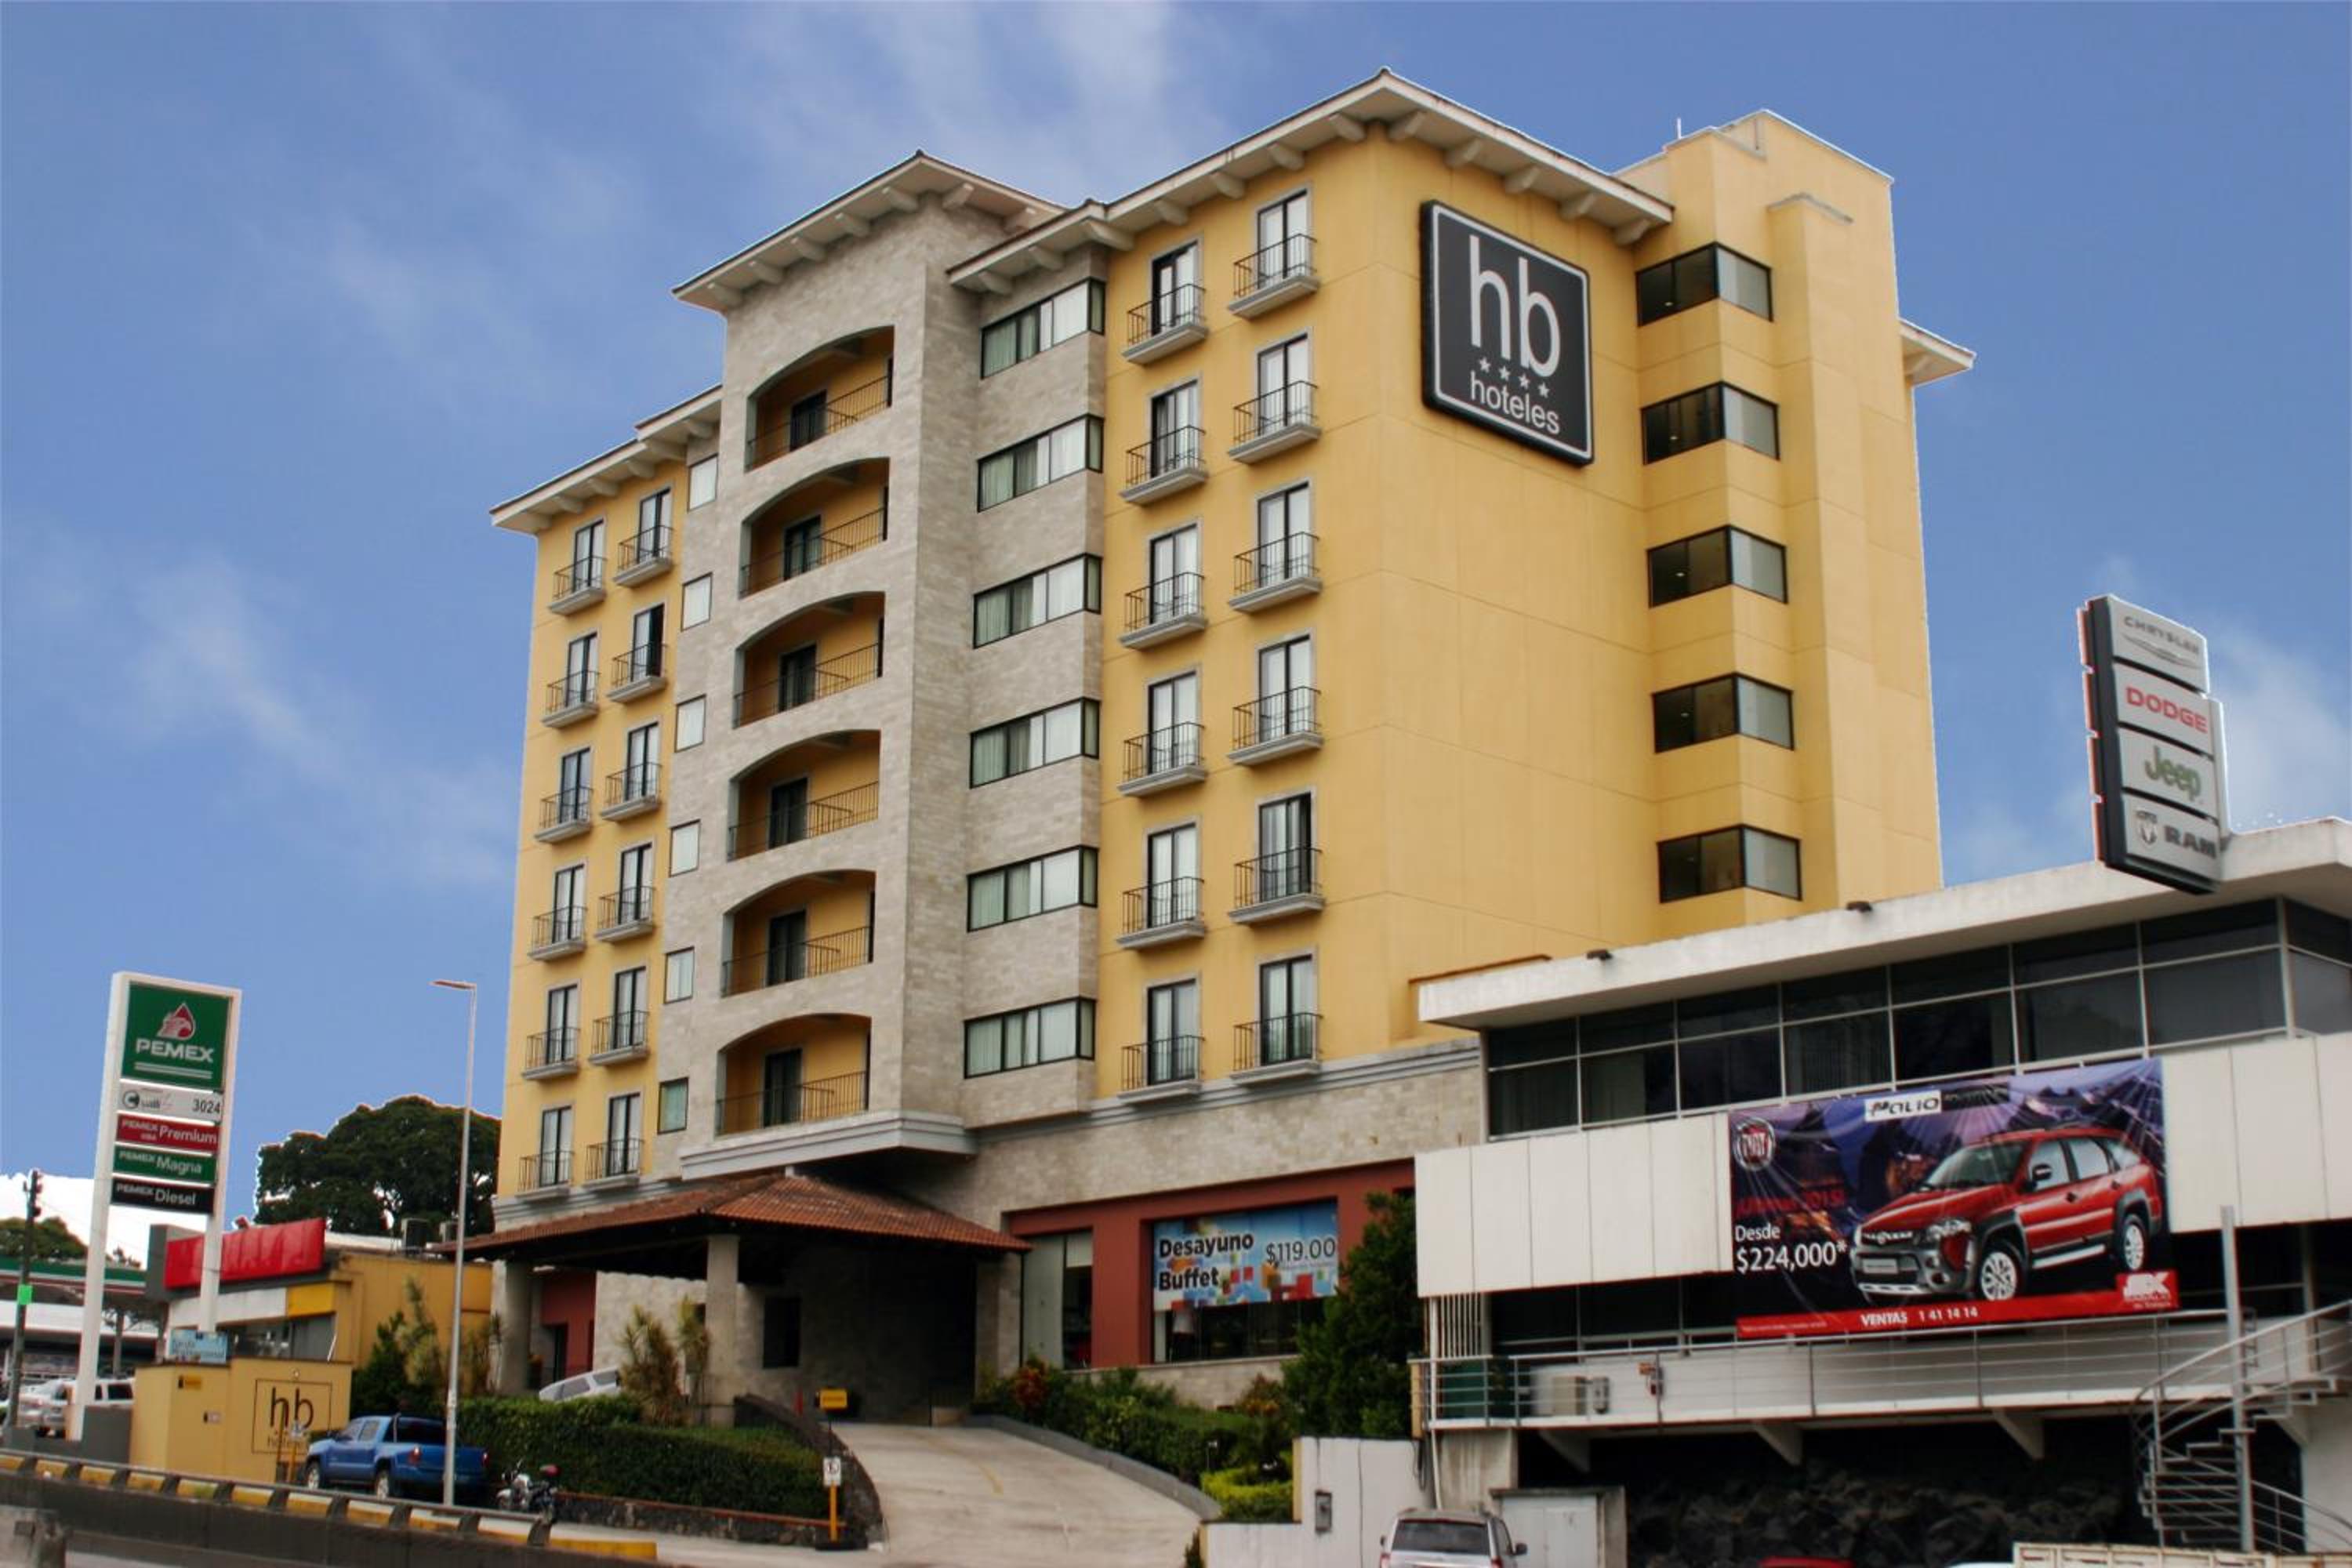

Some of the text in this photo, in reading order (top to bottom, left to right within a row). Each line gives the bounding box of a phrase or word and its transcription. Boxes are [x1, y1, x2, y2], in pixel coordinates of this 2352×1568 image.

[1469, 234, 1560, 377] hb
[1471, 370, 1559, 435] hoteles
[2124, 615, 2198, 655] CHRYSLER
[2125, 686, 2208, 734] DODGE
[2145, 746, 2201, 801] Jeep
[2164, 826, 2216, 859] RAM
[136, 1038, 214, 1063] PEMEX
[159, 1124, 217, 1144] Premium
[156, 1155, 201, 1176] Magna
[155, 1188, 197, 1205] Diesel
[1735, 1221, 1780, 1242] Desde
[1159, 1233, 1254, 1258] Desayuno
[1266, 1237, 1337, 1264] $119.00
[1159, 1266, 1220, 1291] Buffet
[1860, 1310, 1907, 1327] VENTAS
[1929, 1308, 1943, 1321] 41
[1963, 1305, 1979, 1319] 14
[270, 1387, 314, 1430] hb
